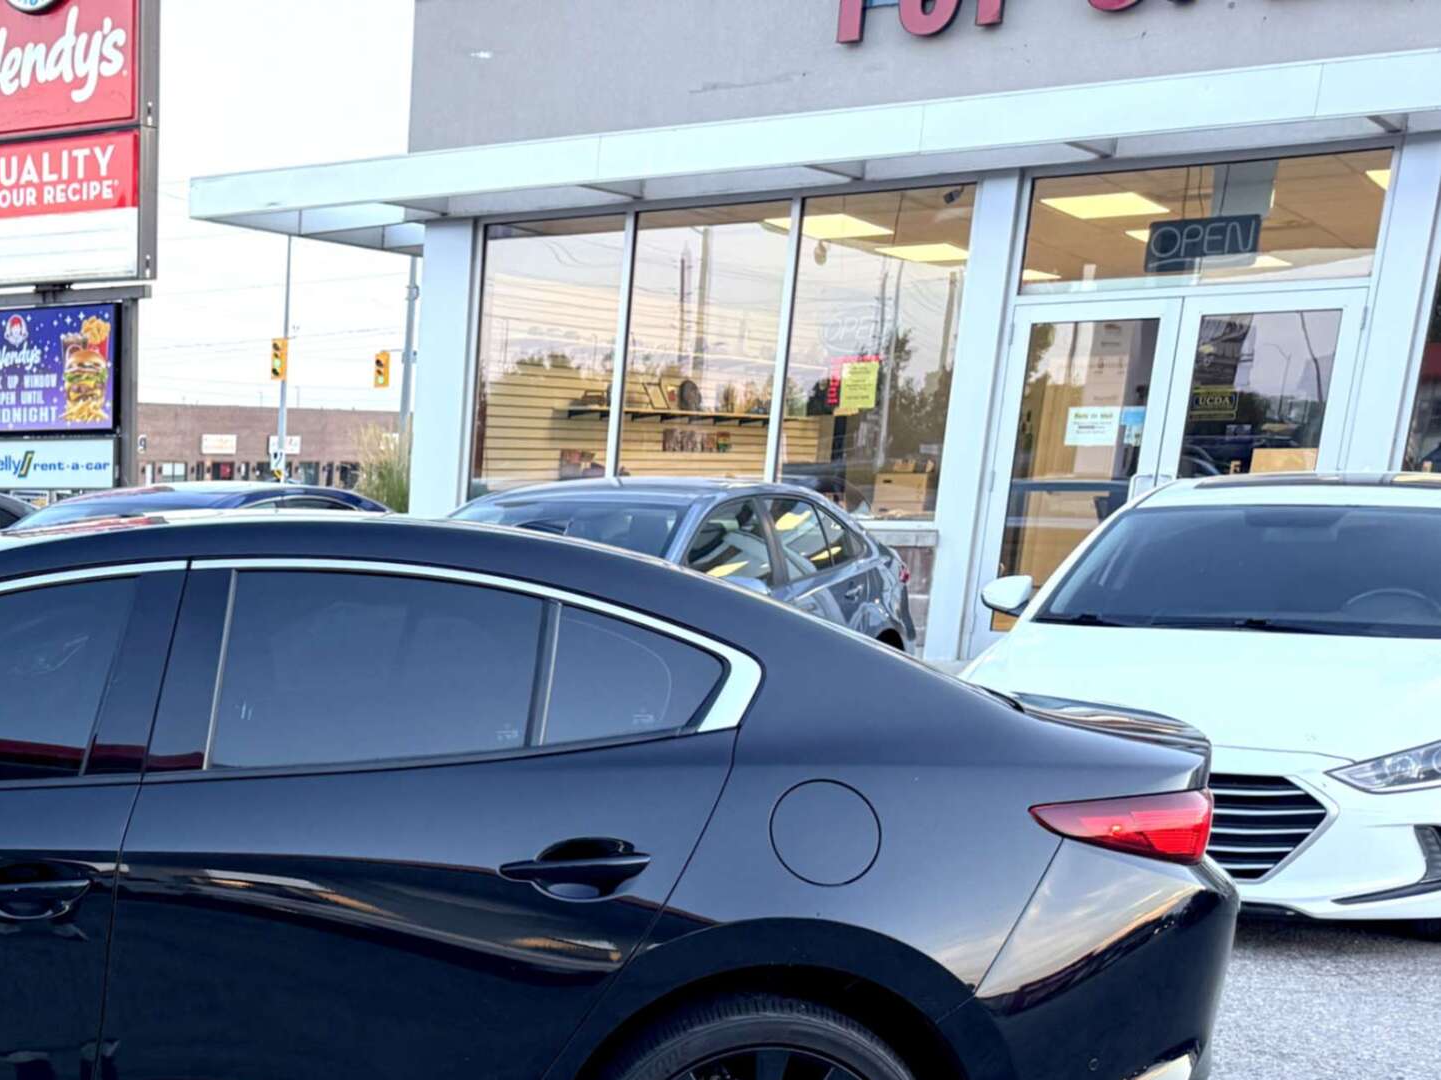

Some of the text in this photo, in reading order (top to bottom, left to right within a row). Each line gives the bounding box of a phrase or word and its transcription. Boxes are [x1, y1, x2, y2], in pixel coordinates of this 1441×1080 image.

[43, 180, 114, 204] RECIPE
[1150, 220, 1256, 258] OPEN
[7, 375, 19, 389] UP
[20, 390, 45, 405] UNTIL
